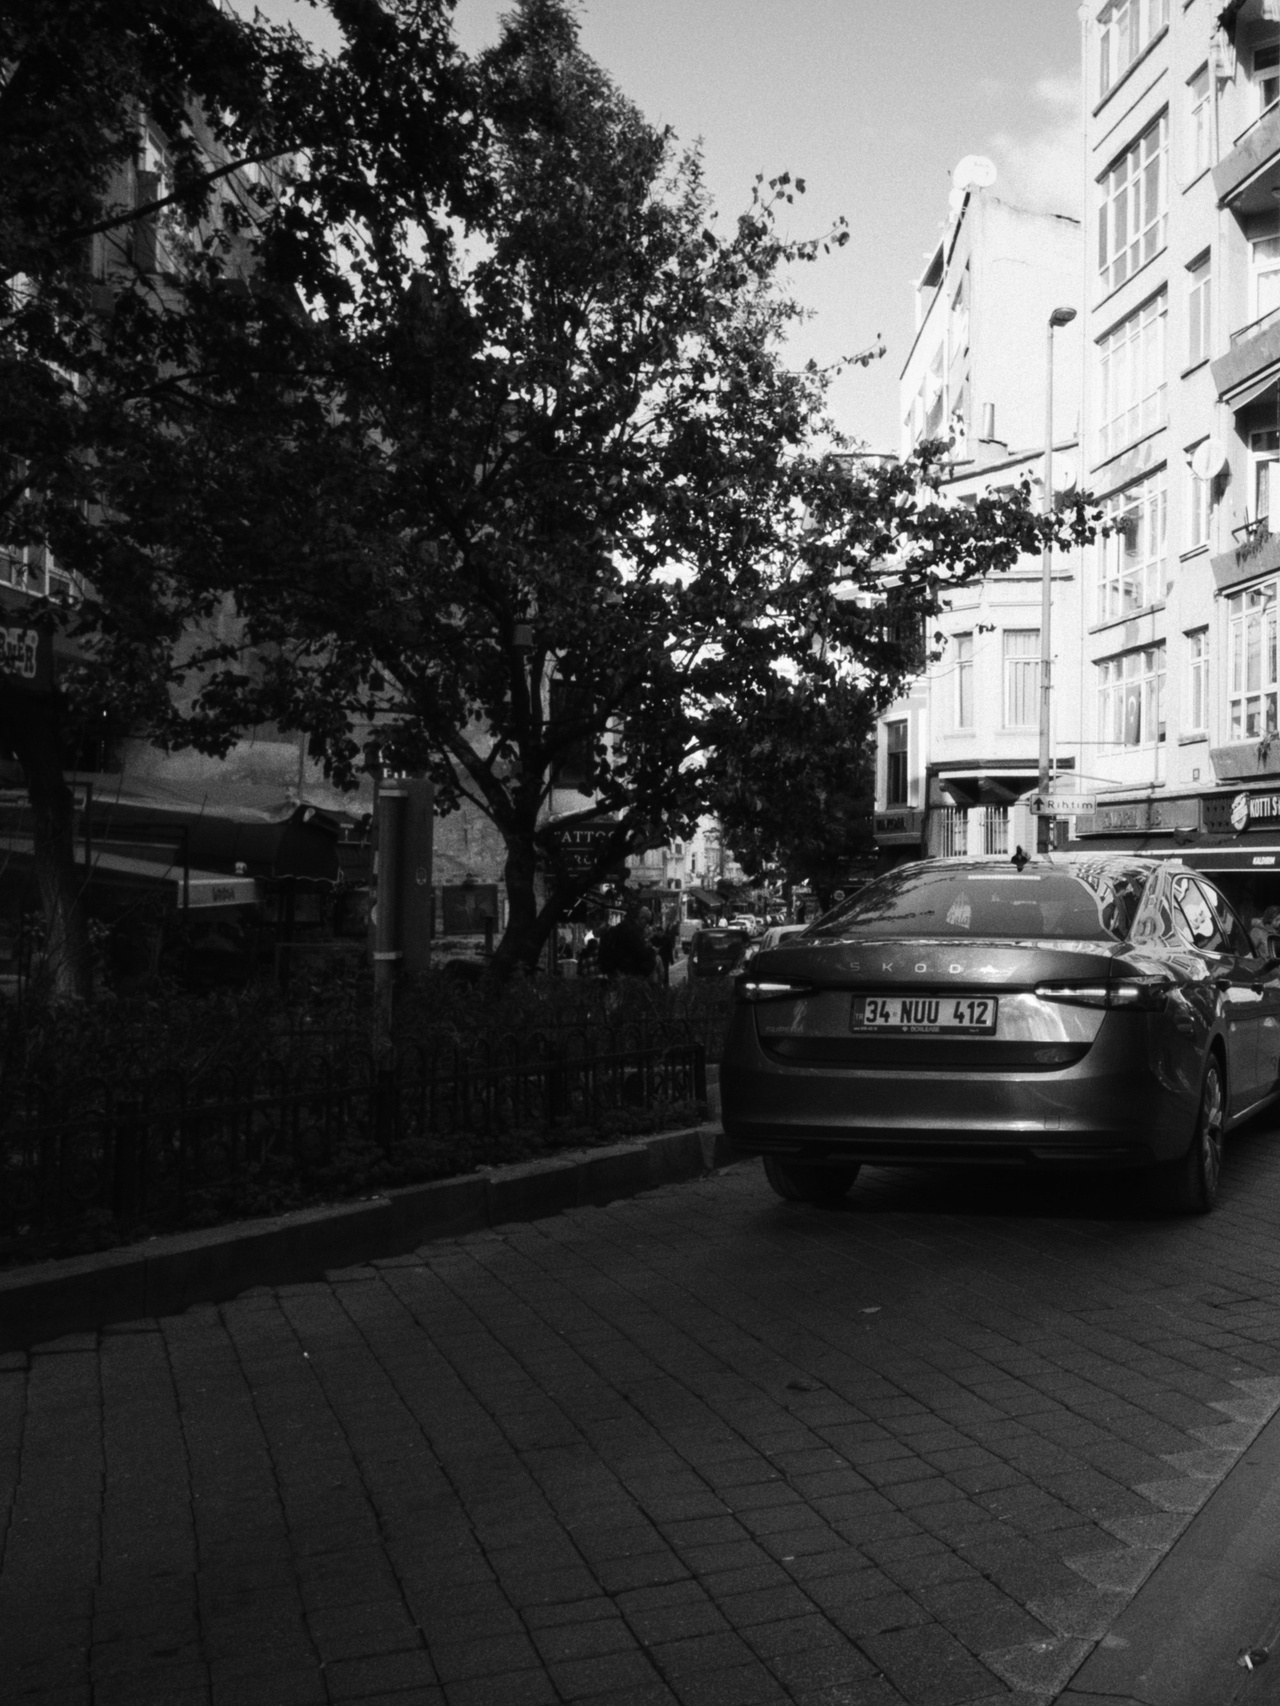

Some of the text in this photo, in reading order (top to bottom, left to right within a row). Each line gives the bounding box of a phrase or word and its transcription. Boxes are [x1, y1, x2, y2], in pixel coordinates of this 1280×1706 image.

[855, 1013, 864, 1021] TR
[866, 1000, 989, 1025] 34 NUU 412
